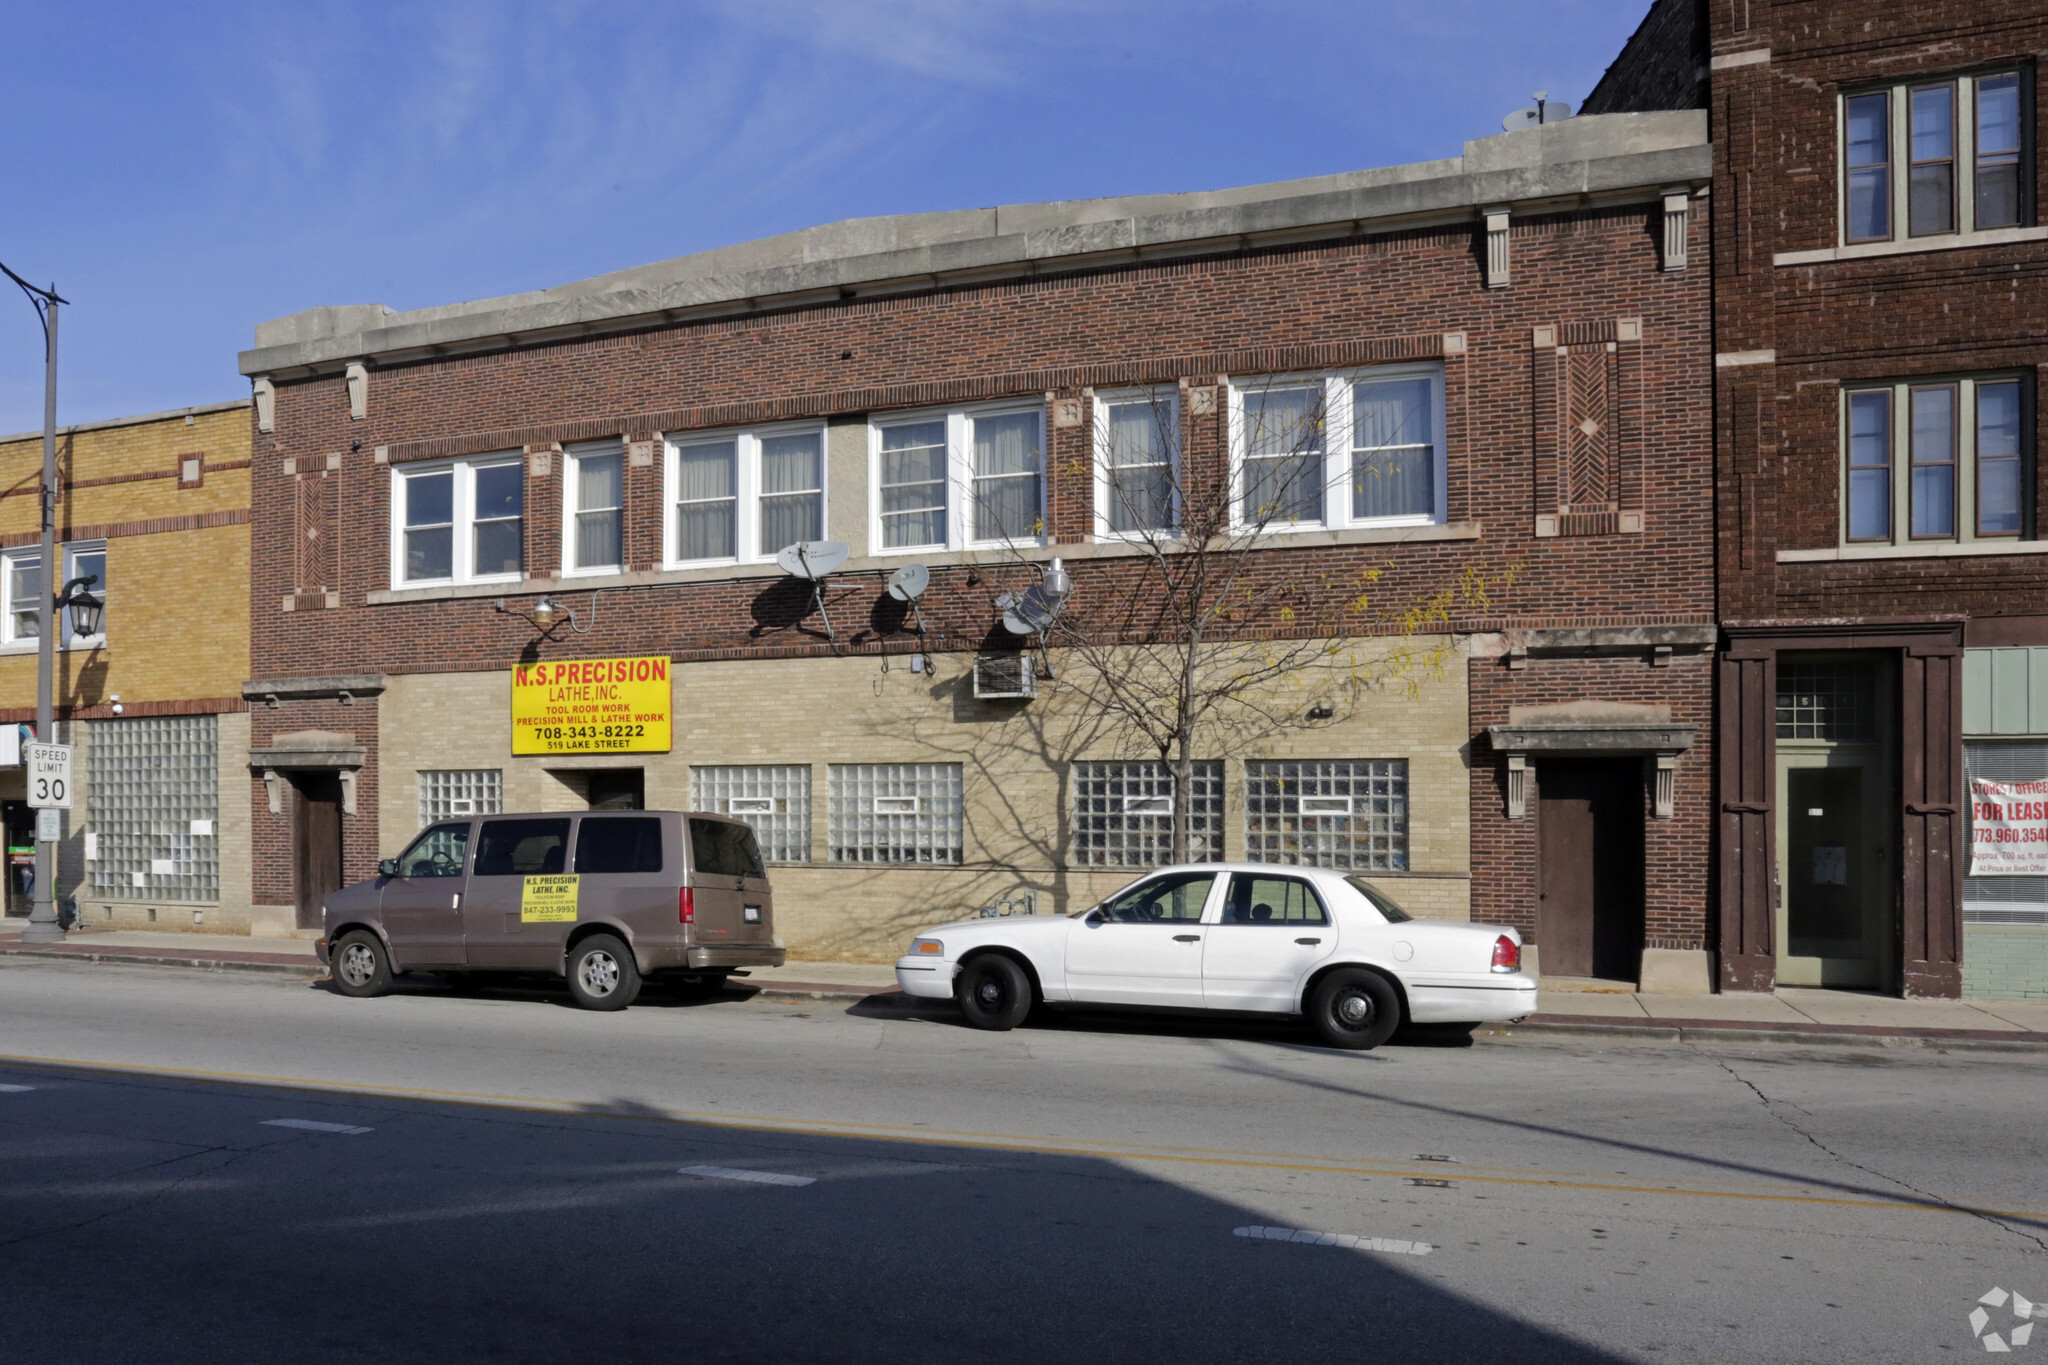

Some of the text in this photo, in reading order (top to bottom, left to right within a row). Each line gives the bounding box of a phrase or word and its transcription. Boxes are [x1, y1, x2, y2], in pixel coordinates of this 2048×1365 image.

[546, 703, 631, 715] TOOL ROOM WORK
[516, 713, 665, 726] PRECISION MILL & LATHE WORK
[534, 724, 645, 740] 708-343-8222
[547, 739, 631, 750] 519 LAKE STREET
[35, 749, 67, 761] SPEED
[38, 763, 63, 773] LIMIT
[36, 778, 65, 801] 30
[1972, 783, 2007, 796] STORES
[1974, 802, 2003, 821] FOR
[2001, 851, 2016, 860] 700
[1987, 864, 2004, 872] Price
[2013, 864, 2029, 872] Best
[2029, 864, 2047, 872] Offer
[526, 876, 577, 885] N.S. PRECISION
[555, 885, 570, 894] INC.
[523, 905, 576, 914] 847-233-9993
